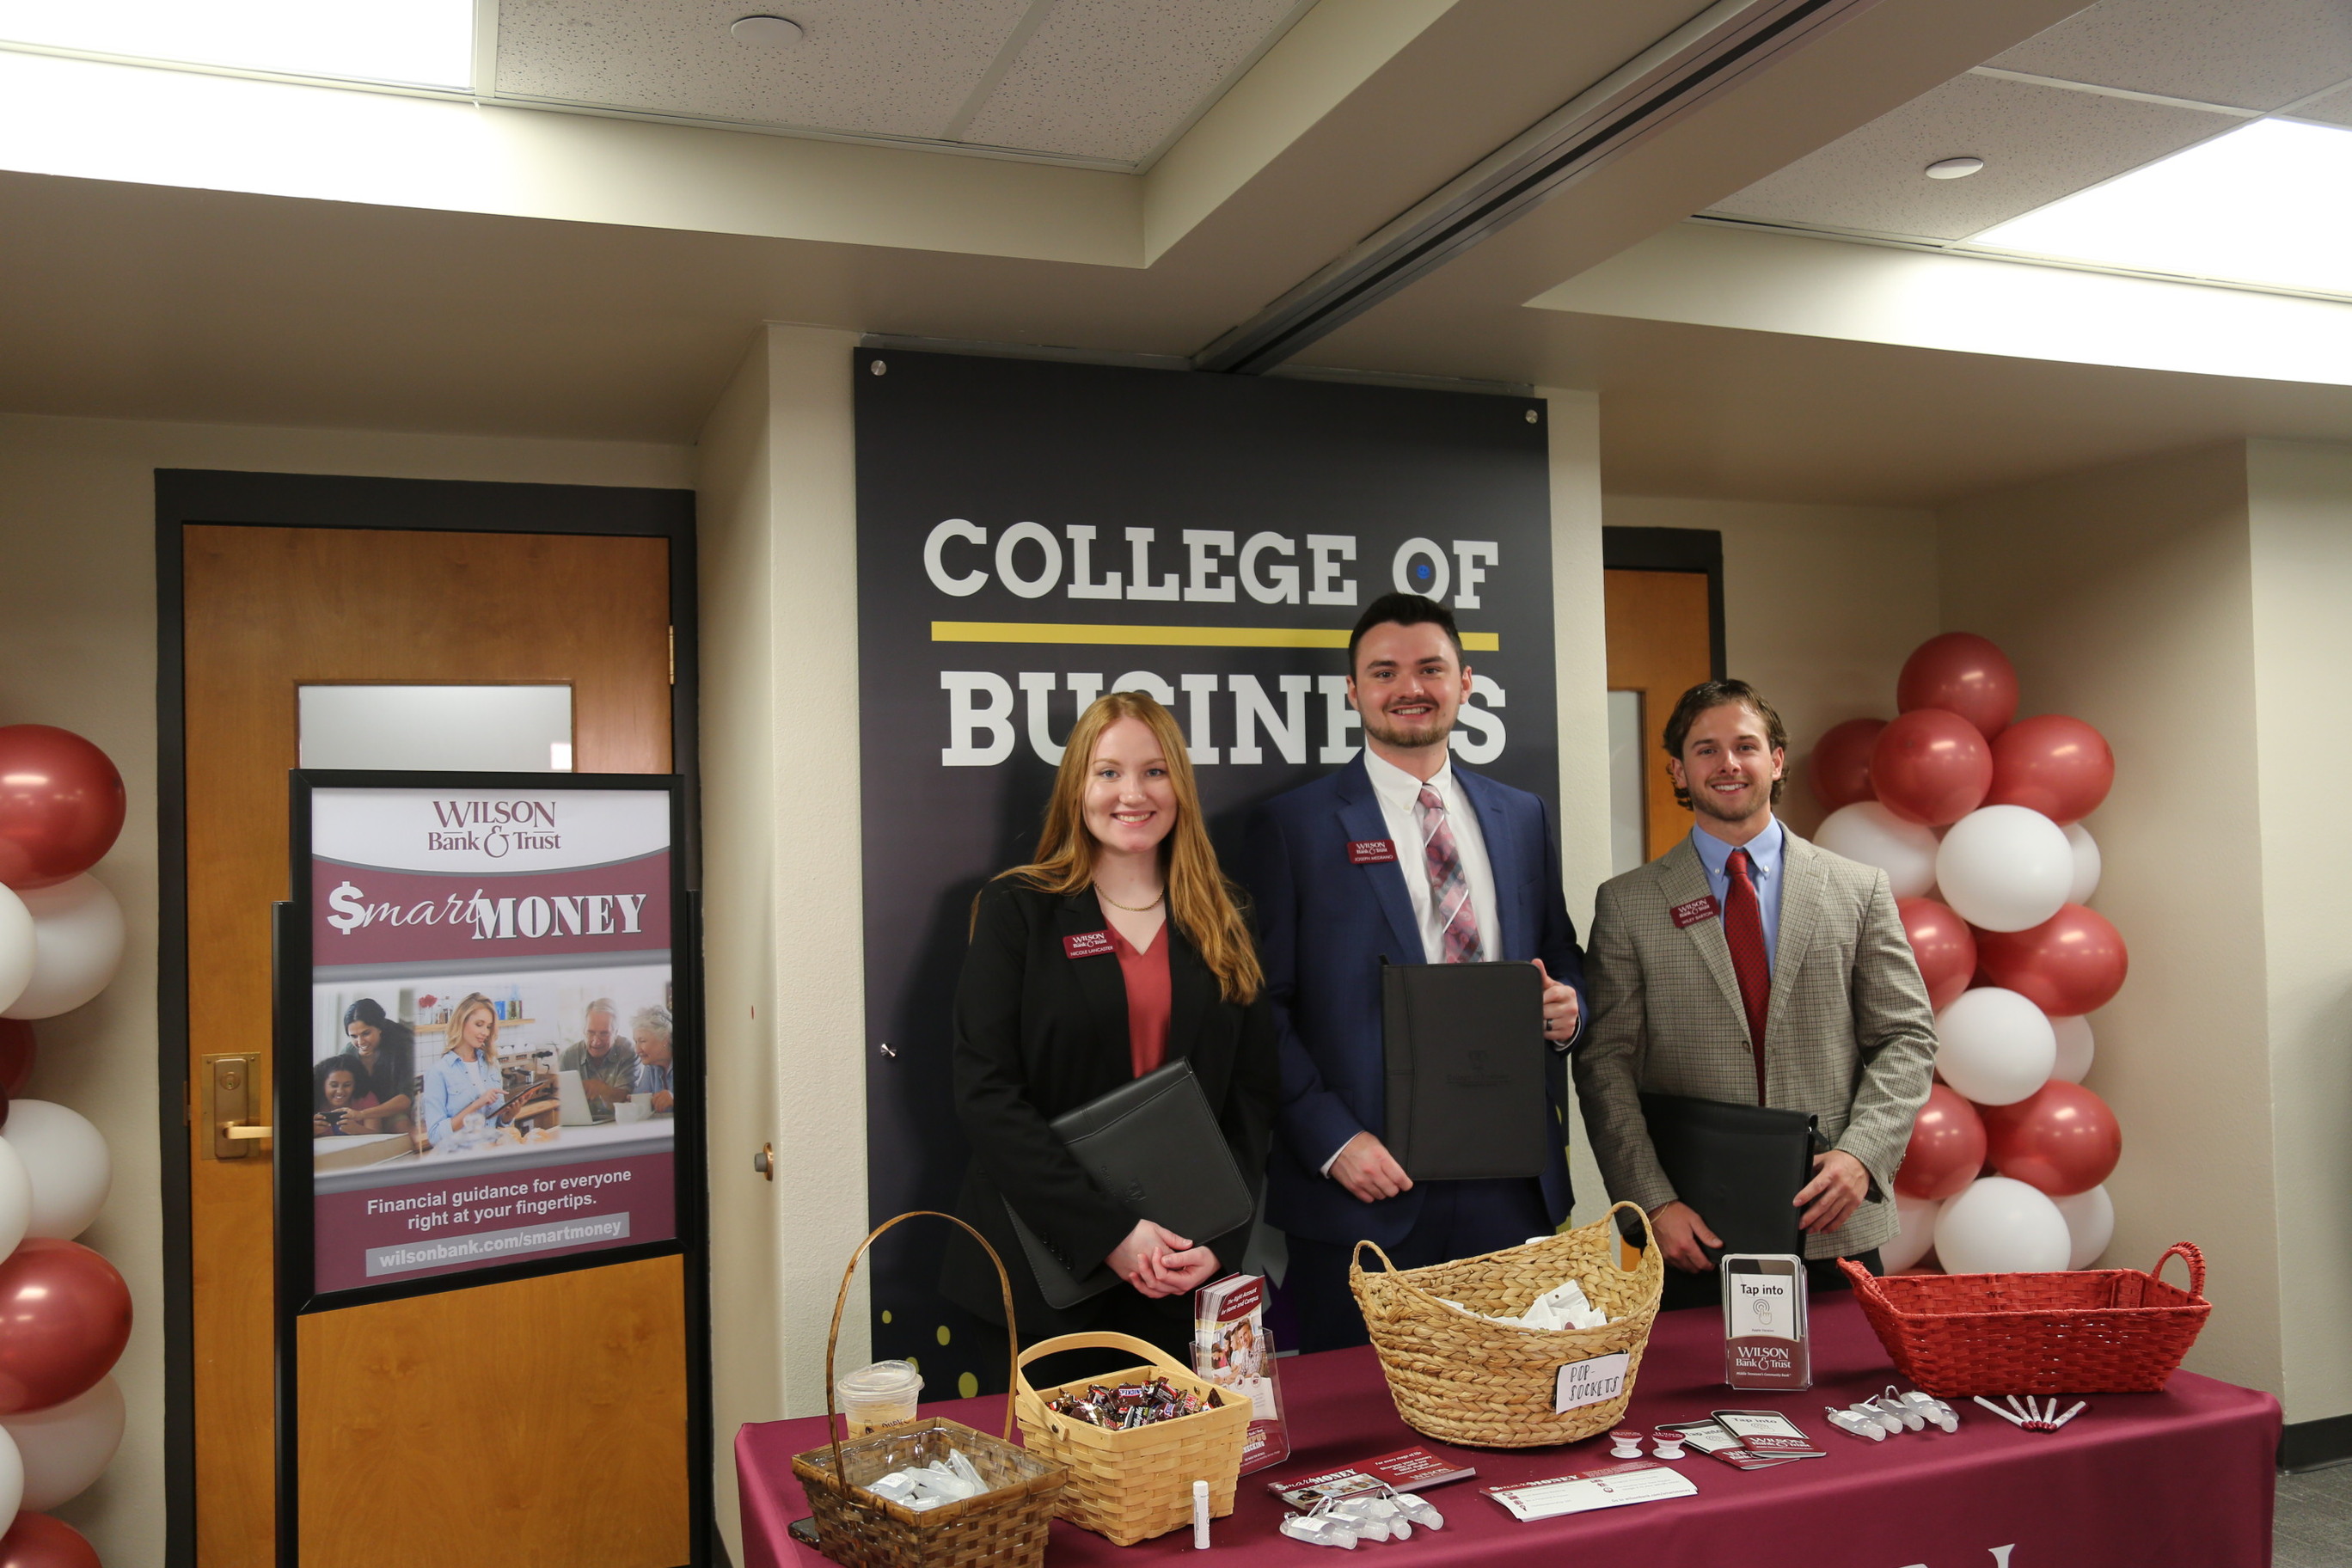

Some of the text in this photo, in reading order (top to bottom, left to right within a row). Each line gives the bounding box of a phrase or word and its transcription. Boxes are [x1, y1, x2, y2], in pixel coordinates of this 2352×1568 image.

[924, 518, 1499, 609] COLLEGE OF
[940, 670, 1507, 768] BUINES
[432, 800, 555, 828] WILSON
[428, 825, 561, 858] Bank & Trust
[1678, 898, 1707, 912] WILSON
[1073, 933, 1105, 943] WILSON
[367, 1170, 632, 1215] Financial guidance for everyone
[407, 1191, 597, 1231] right at your fingertips.
[380, 1221, 622, 1267] wilsonbank.com/smartmoney
[1741, 1283, 1784, 1295] Tap into
[1736, 1357, 1792, 1370] Bank & Trust
[1737, 1346, 1789, 1360] WILSON
[1570, 1364, 1596, 1382] POP-
[1568, 1375, 1620, 1401] SOCKETS
